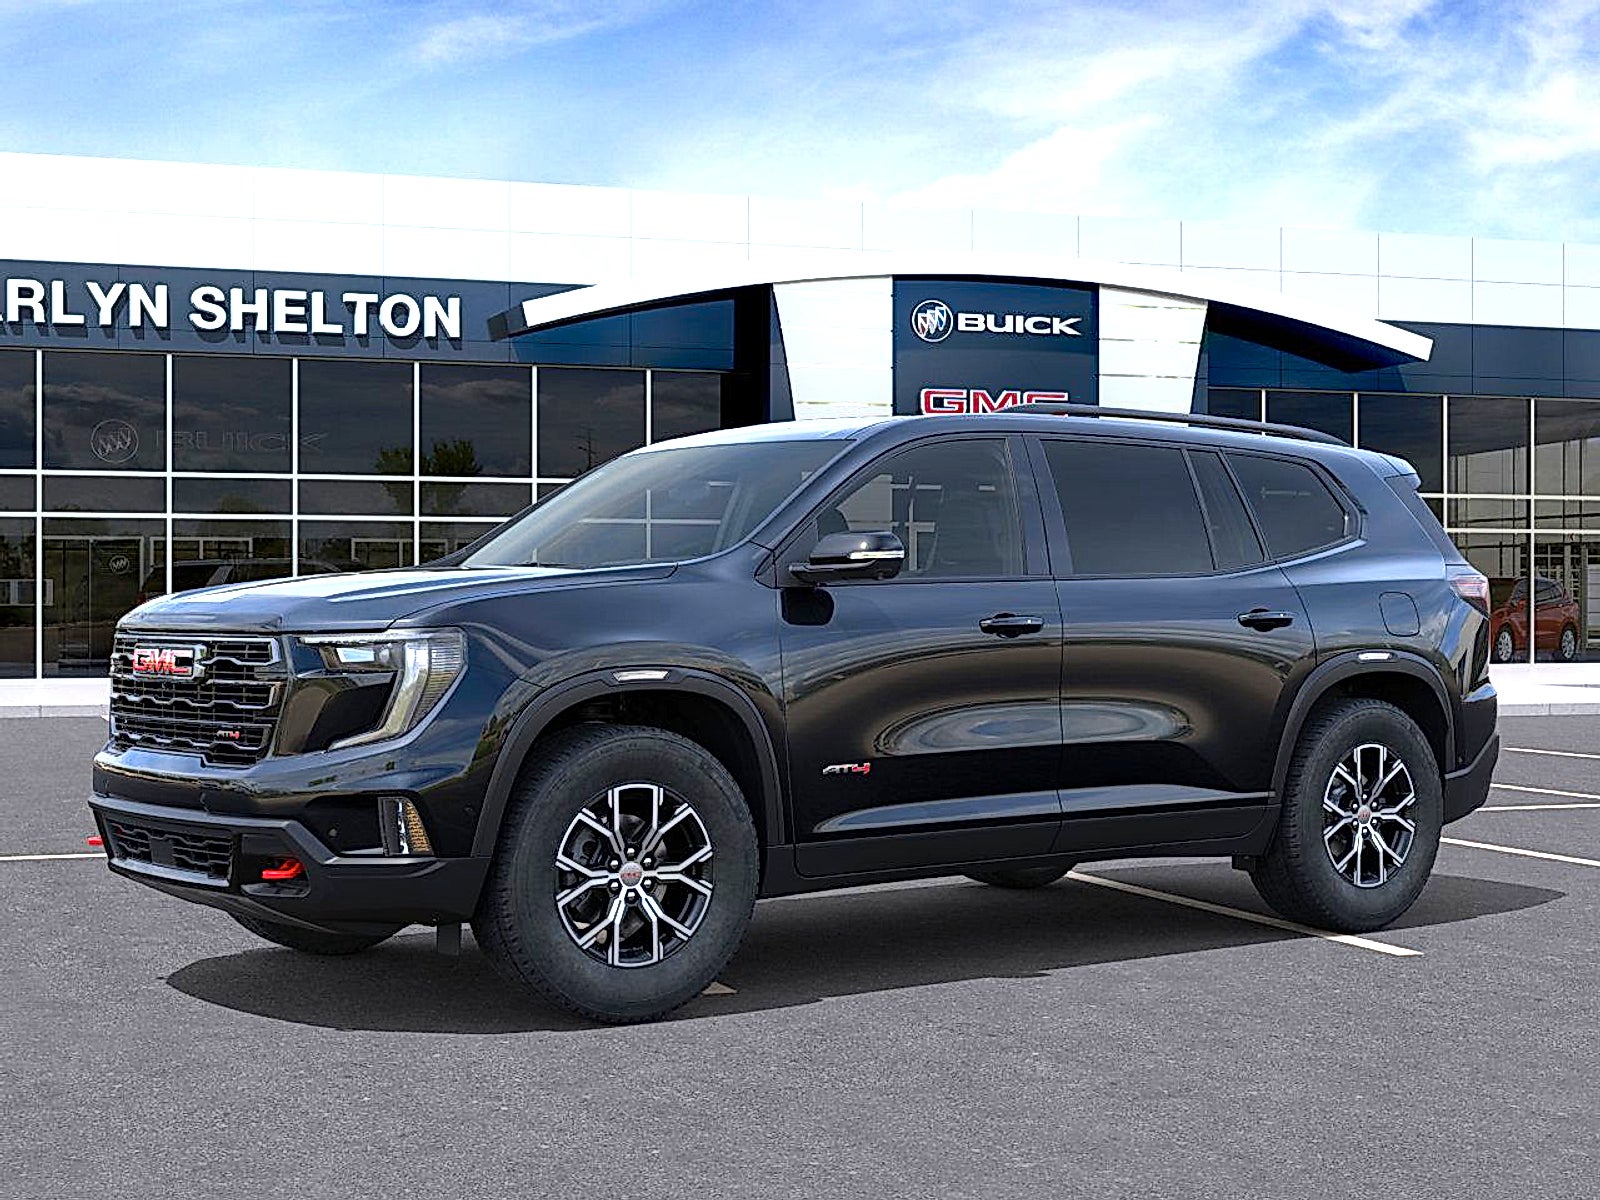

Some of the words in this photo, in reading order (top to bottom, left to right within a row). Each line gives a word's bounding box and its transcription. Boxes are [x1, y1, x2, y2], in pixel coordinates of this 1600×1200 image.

[0, 278, 168, 328] RLYN
[188, 285, 461, 338] SHELTON
[957, 312, 1082, 336] BUICK
[133, 648, 194, 674] GMC
